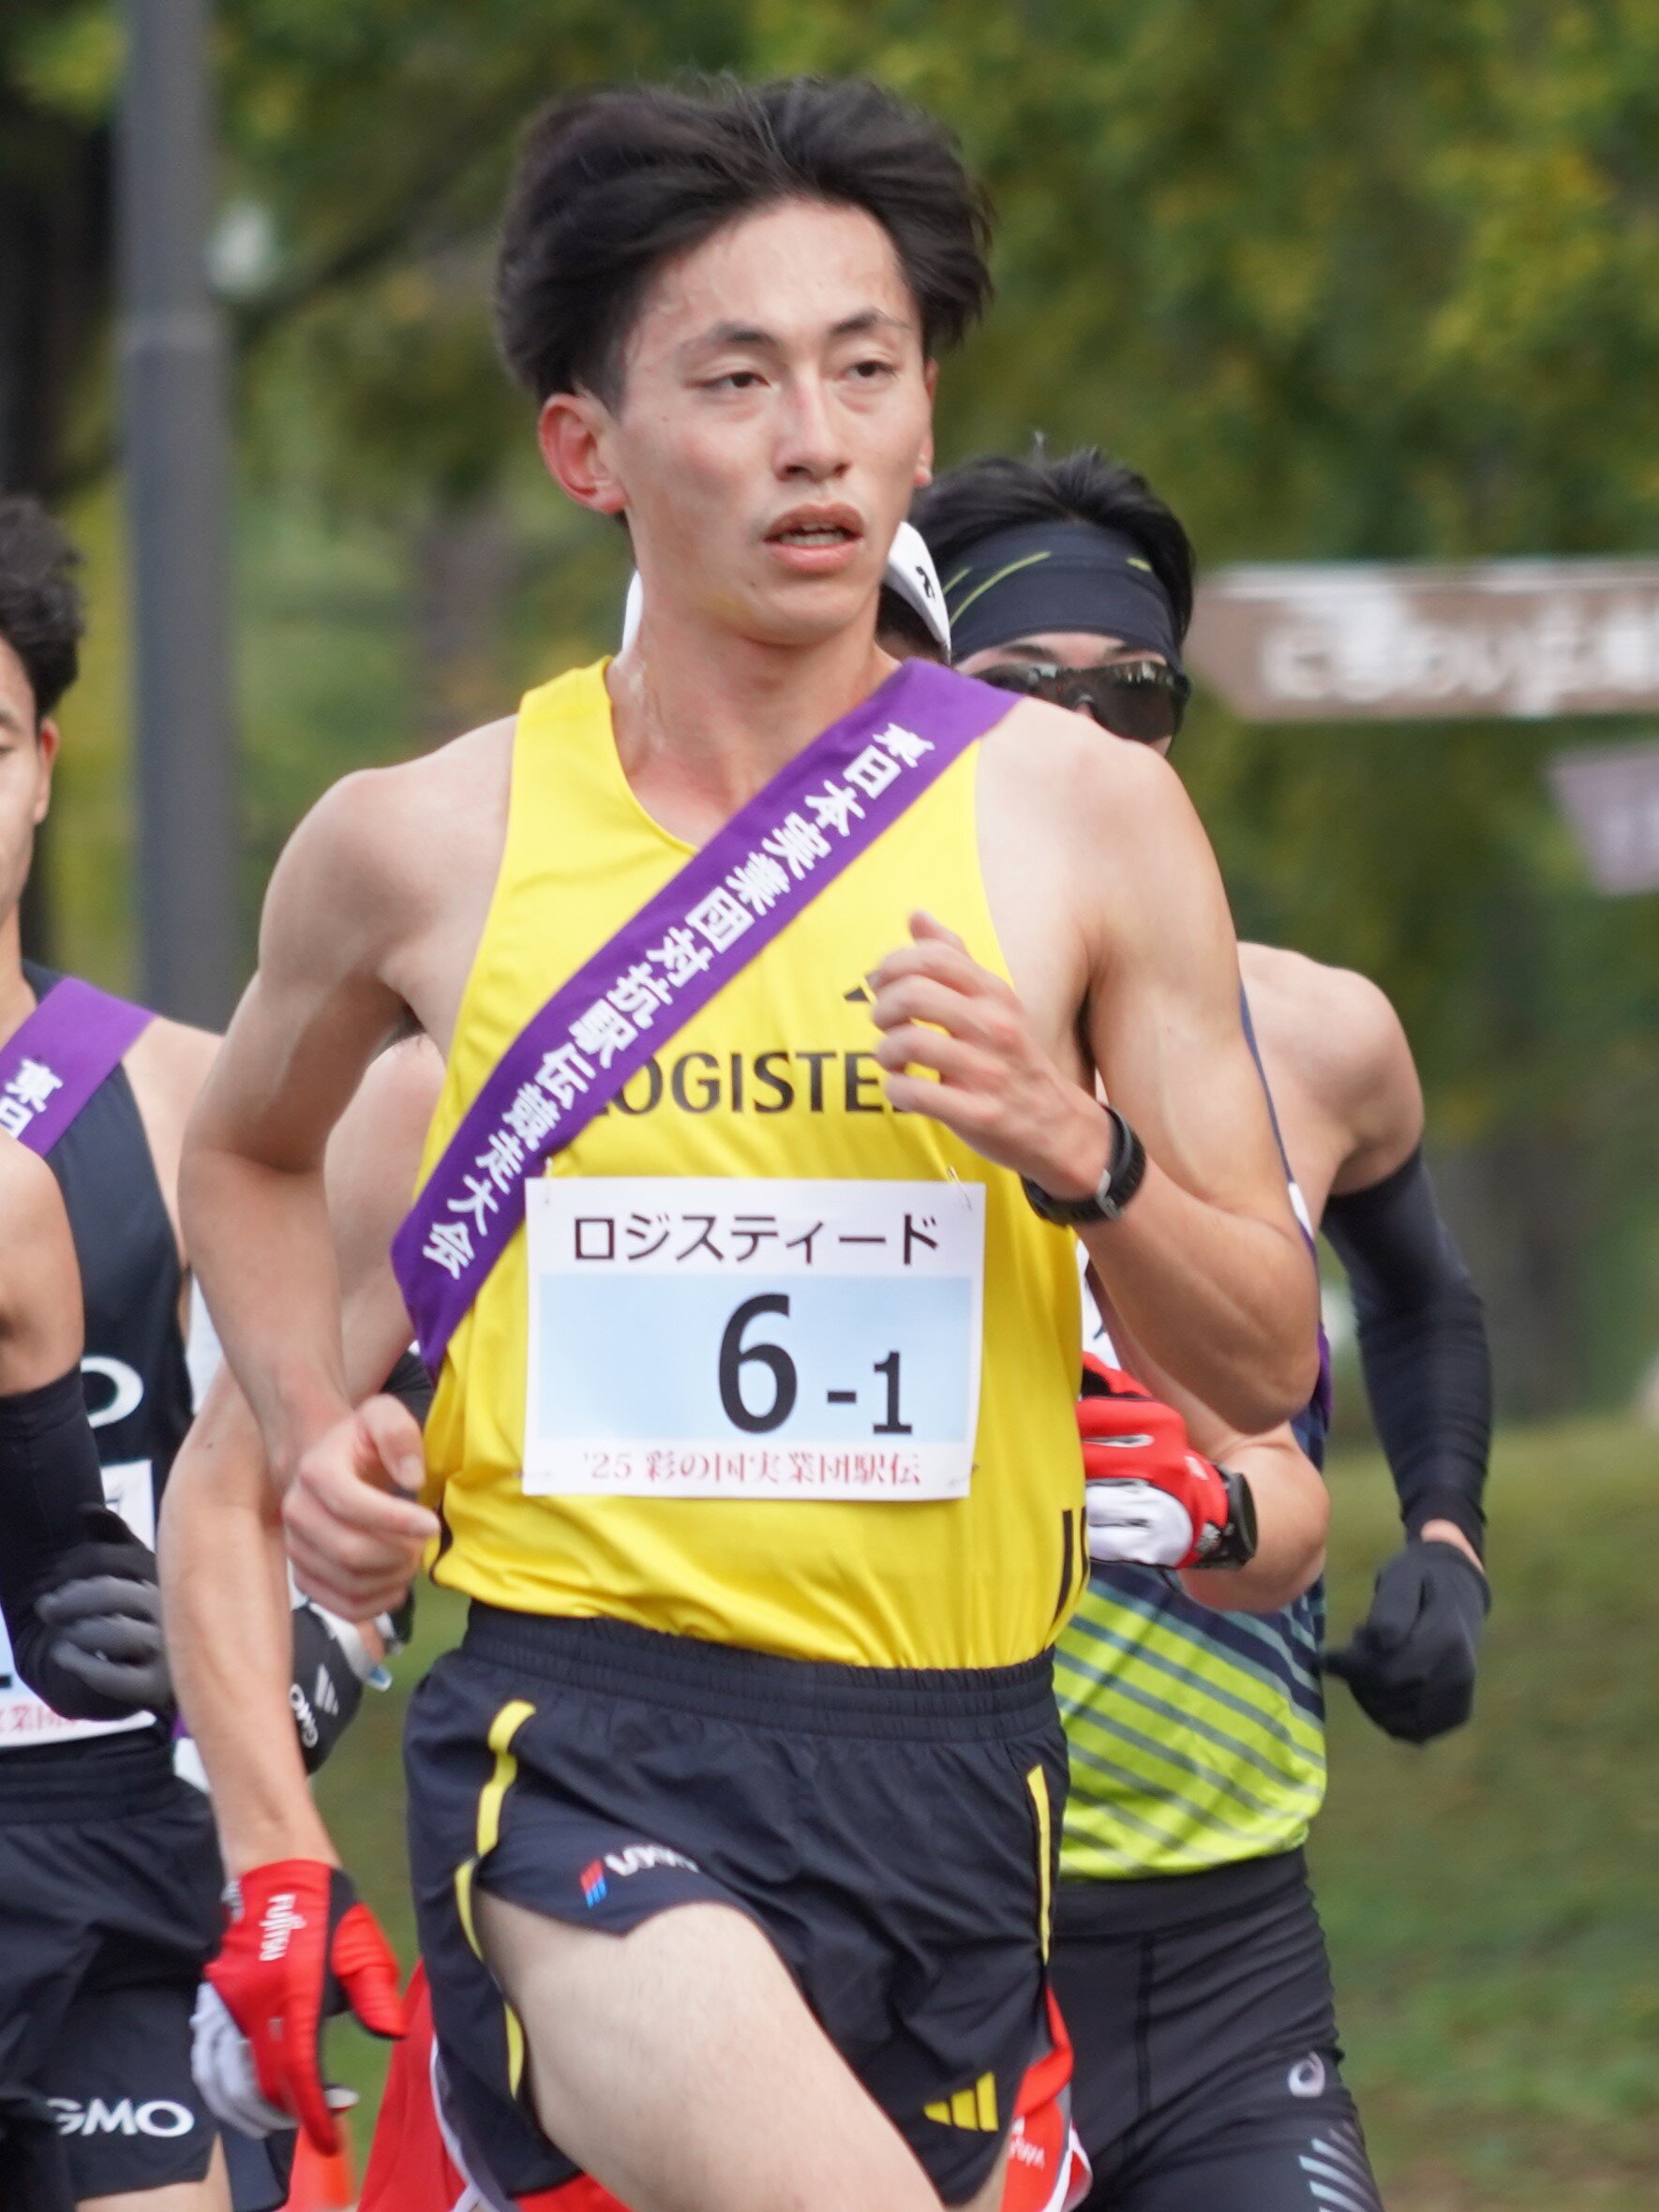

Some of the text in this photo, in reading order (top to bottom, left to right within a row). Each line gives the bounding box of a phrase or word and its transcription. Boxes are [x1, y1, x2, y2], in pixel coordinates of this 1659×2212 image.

[600, 1050, 909, 1116] OGISTE
[574, 1212, 939, 1265] ロジスティード
[646, 1450, 921, 1485] 彩の国実業団駅伝
[46, 2098, 195, 2138] GMO
